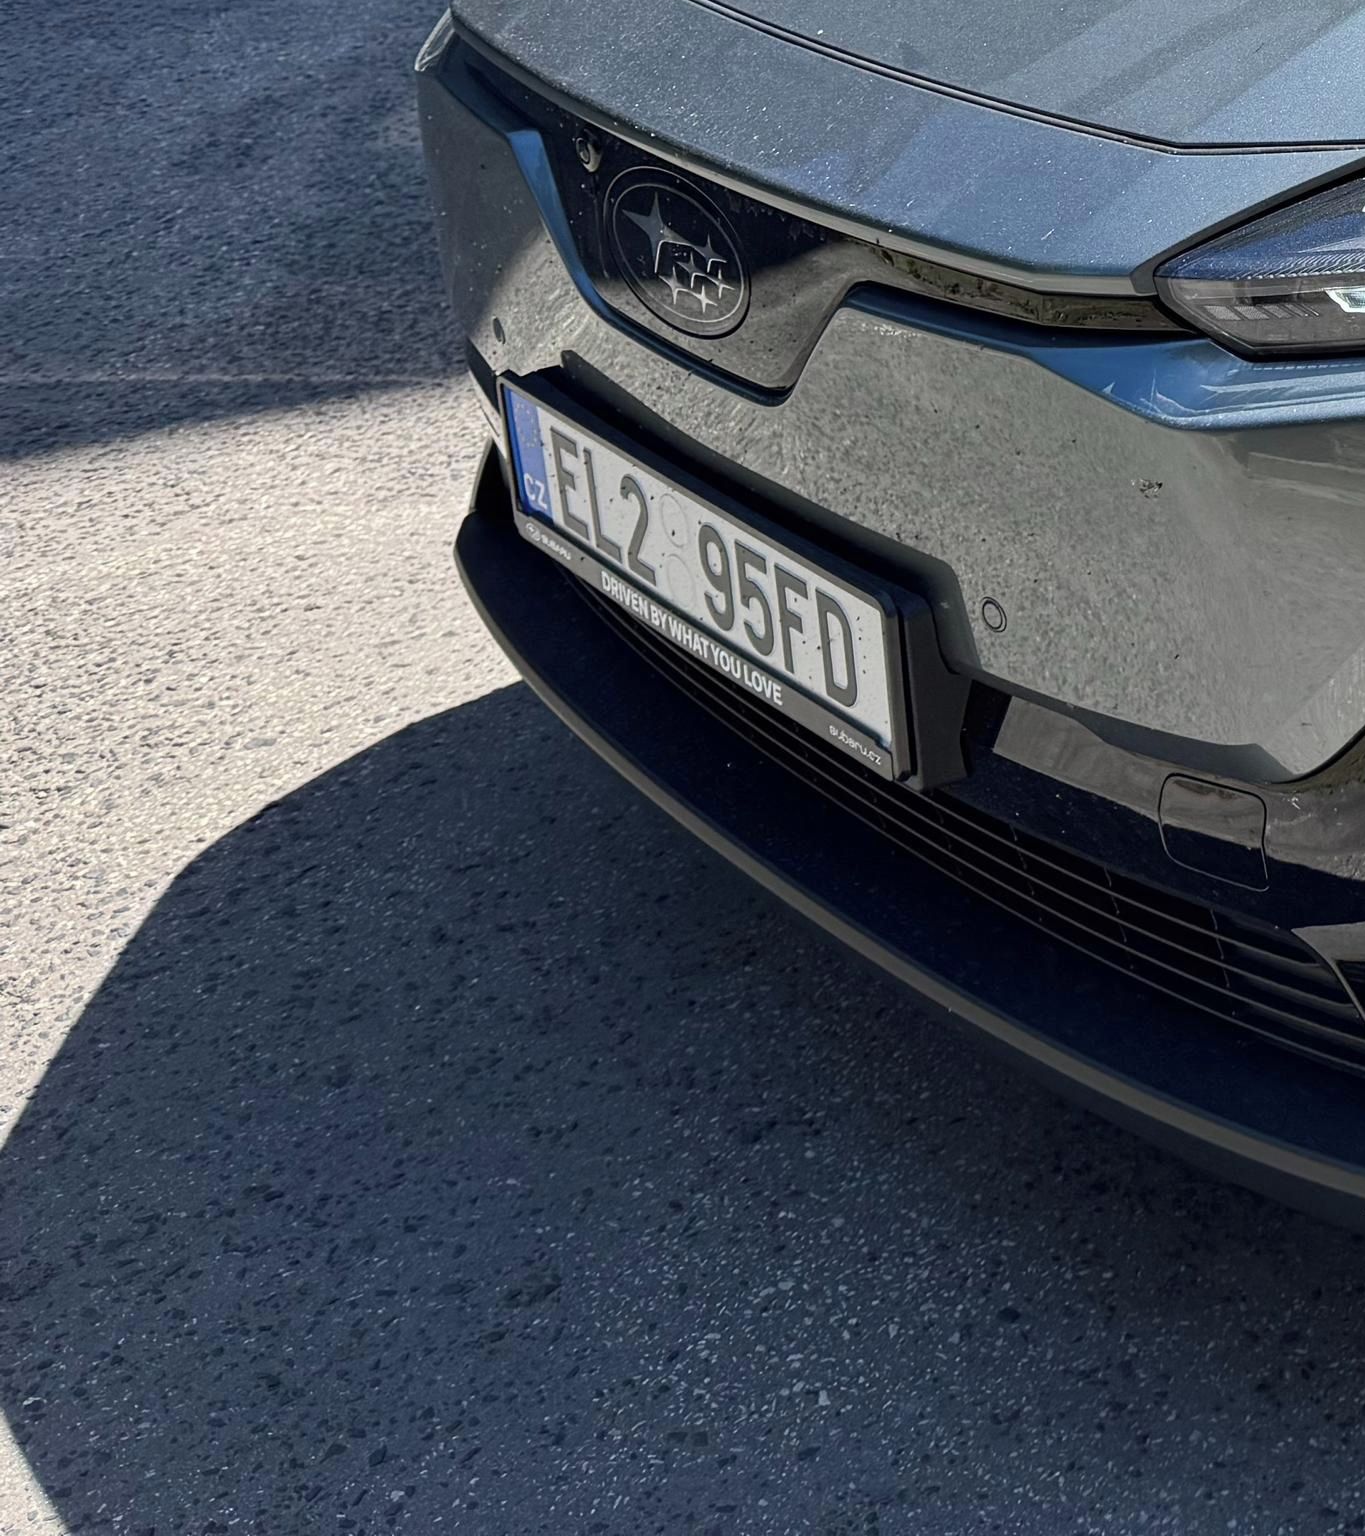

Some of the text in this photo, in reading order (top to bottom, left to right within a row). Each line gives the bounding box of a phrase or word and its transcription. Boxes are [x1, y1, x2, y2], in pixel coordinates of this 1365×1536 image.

[522, 471, 549, 511] CZ
[549, 425, 859, 708] EL2 95FD
[601, 571, 783, 707] DRIVEN BY WHAT YOU LOVE
